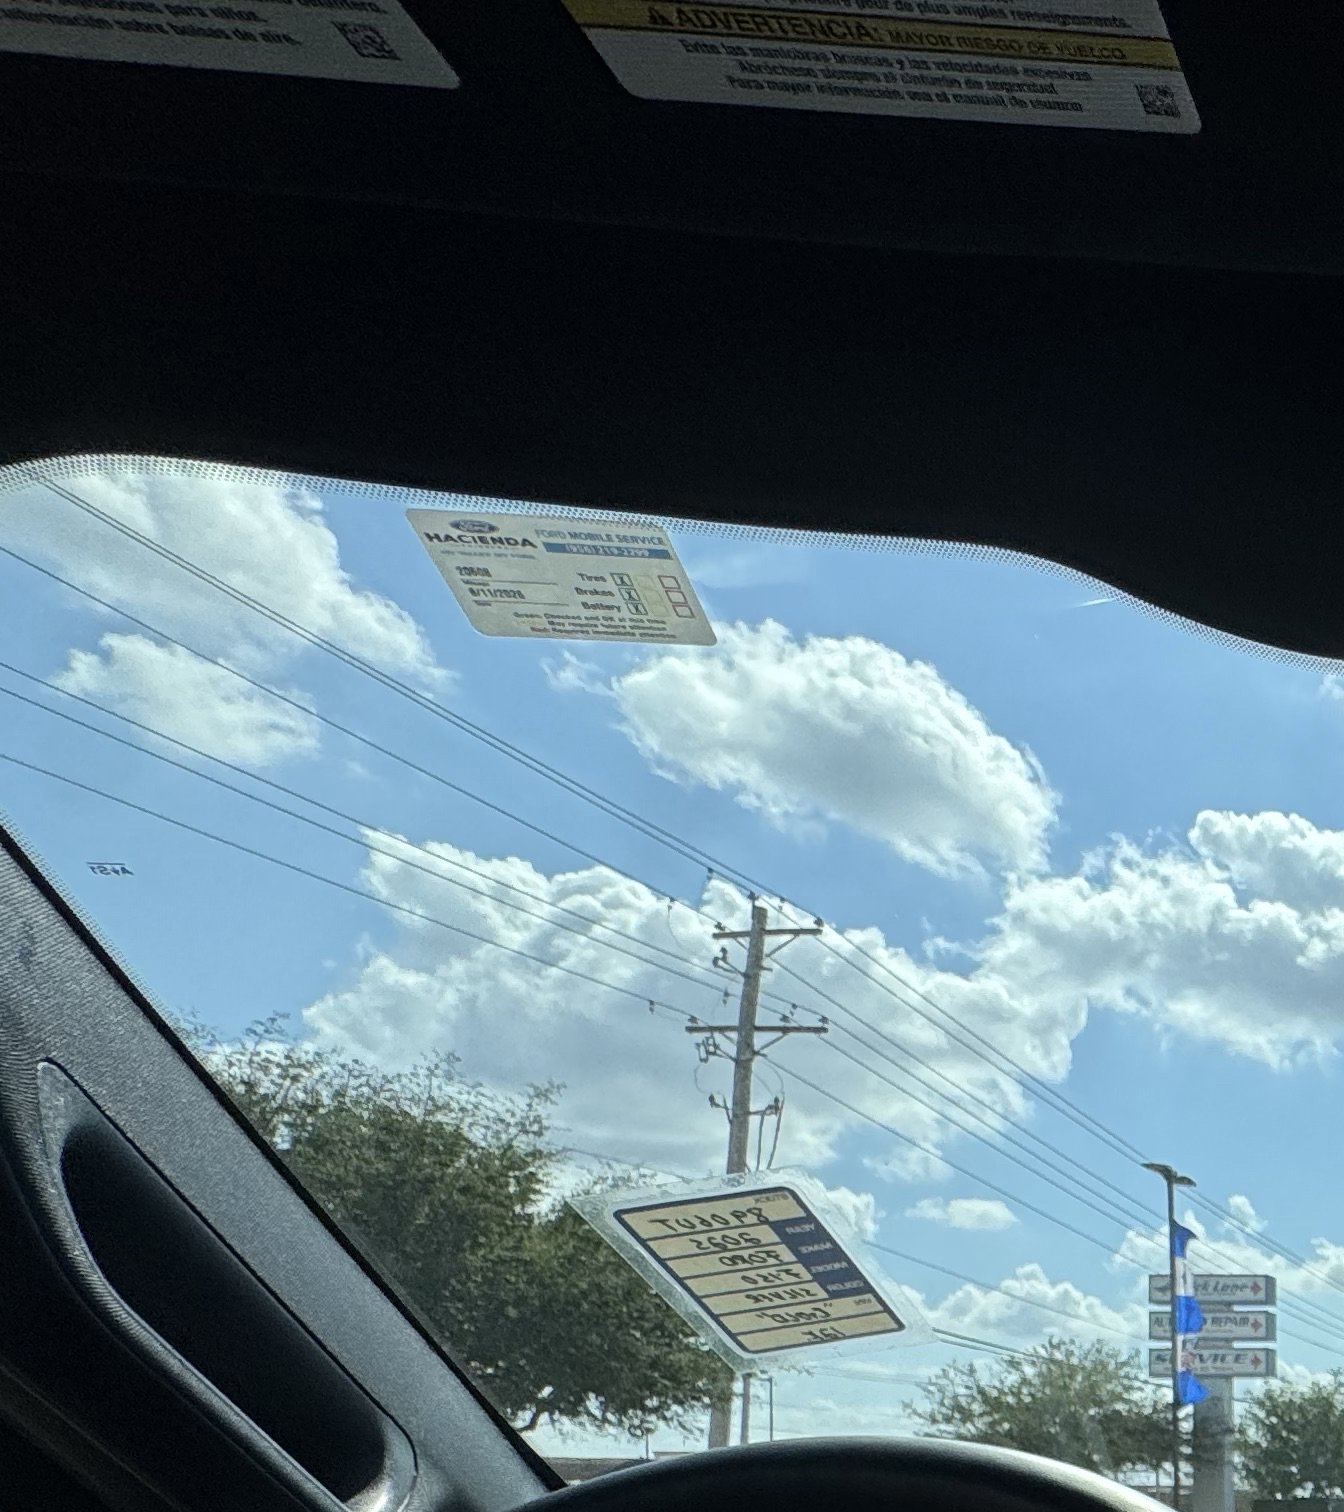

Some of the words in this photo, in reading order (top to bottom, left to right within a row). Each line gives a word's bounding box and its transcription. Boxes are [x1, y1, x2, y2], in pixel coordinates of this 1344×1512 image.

[676, 8, 886, 43] ADVERTENCIA:
[888, 31, 954, 47] MAYOR
[423, 532, 538, 549] HACIENDA
[566, 530, 615, 543] MOBILE
[614, 534, 666, 547] SERVICE
[577, 572, 607, 583] Tires
[580, 600, 622, 613] Battery
[1211, 1317, 1249, 1328] REPAIR
